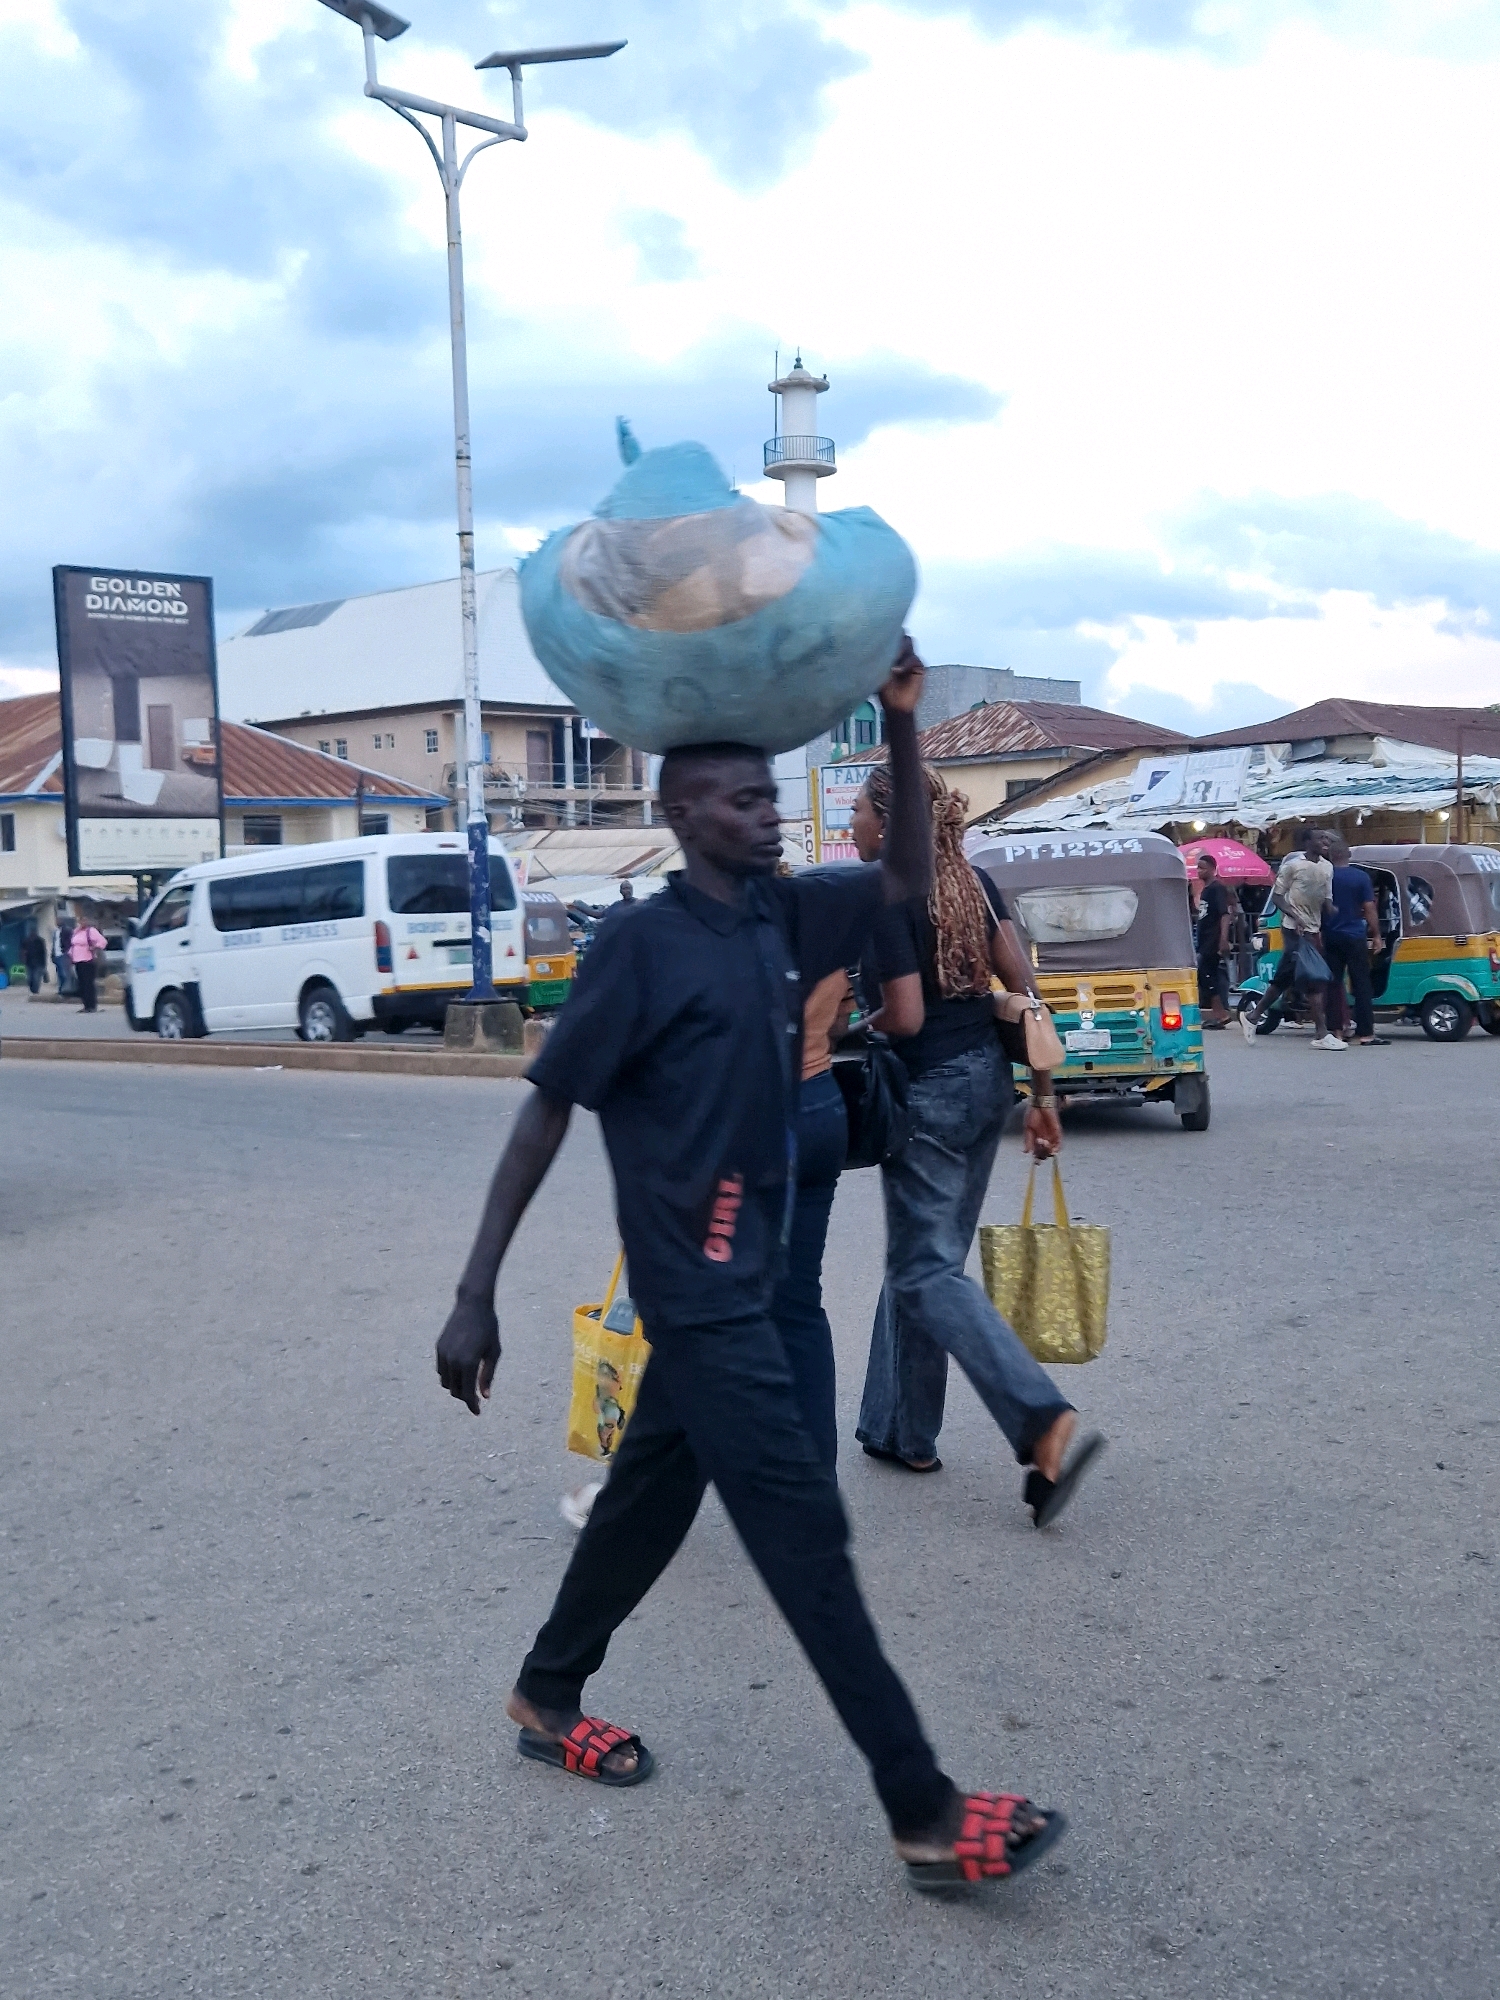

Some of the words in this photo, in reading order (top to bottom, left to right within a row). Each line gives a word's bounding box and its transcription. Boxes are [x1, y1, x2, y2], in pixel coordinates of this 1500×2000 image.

[91, 576, 181, 598] GOLDEN
[86, 594, 188, 615] DIAMOND
[834, 768, 874, 785] FAM
